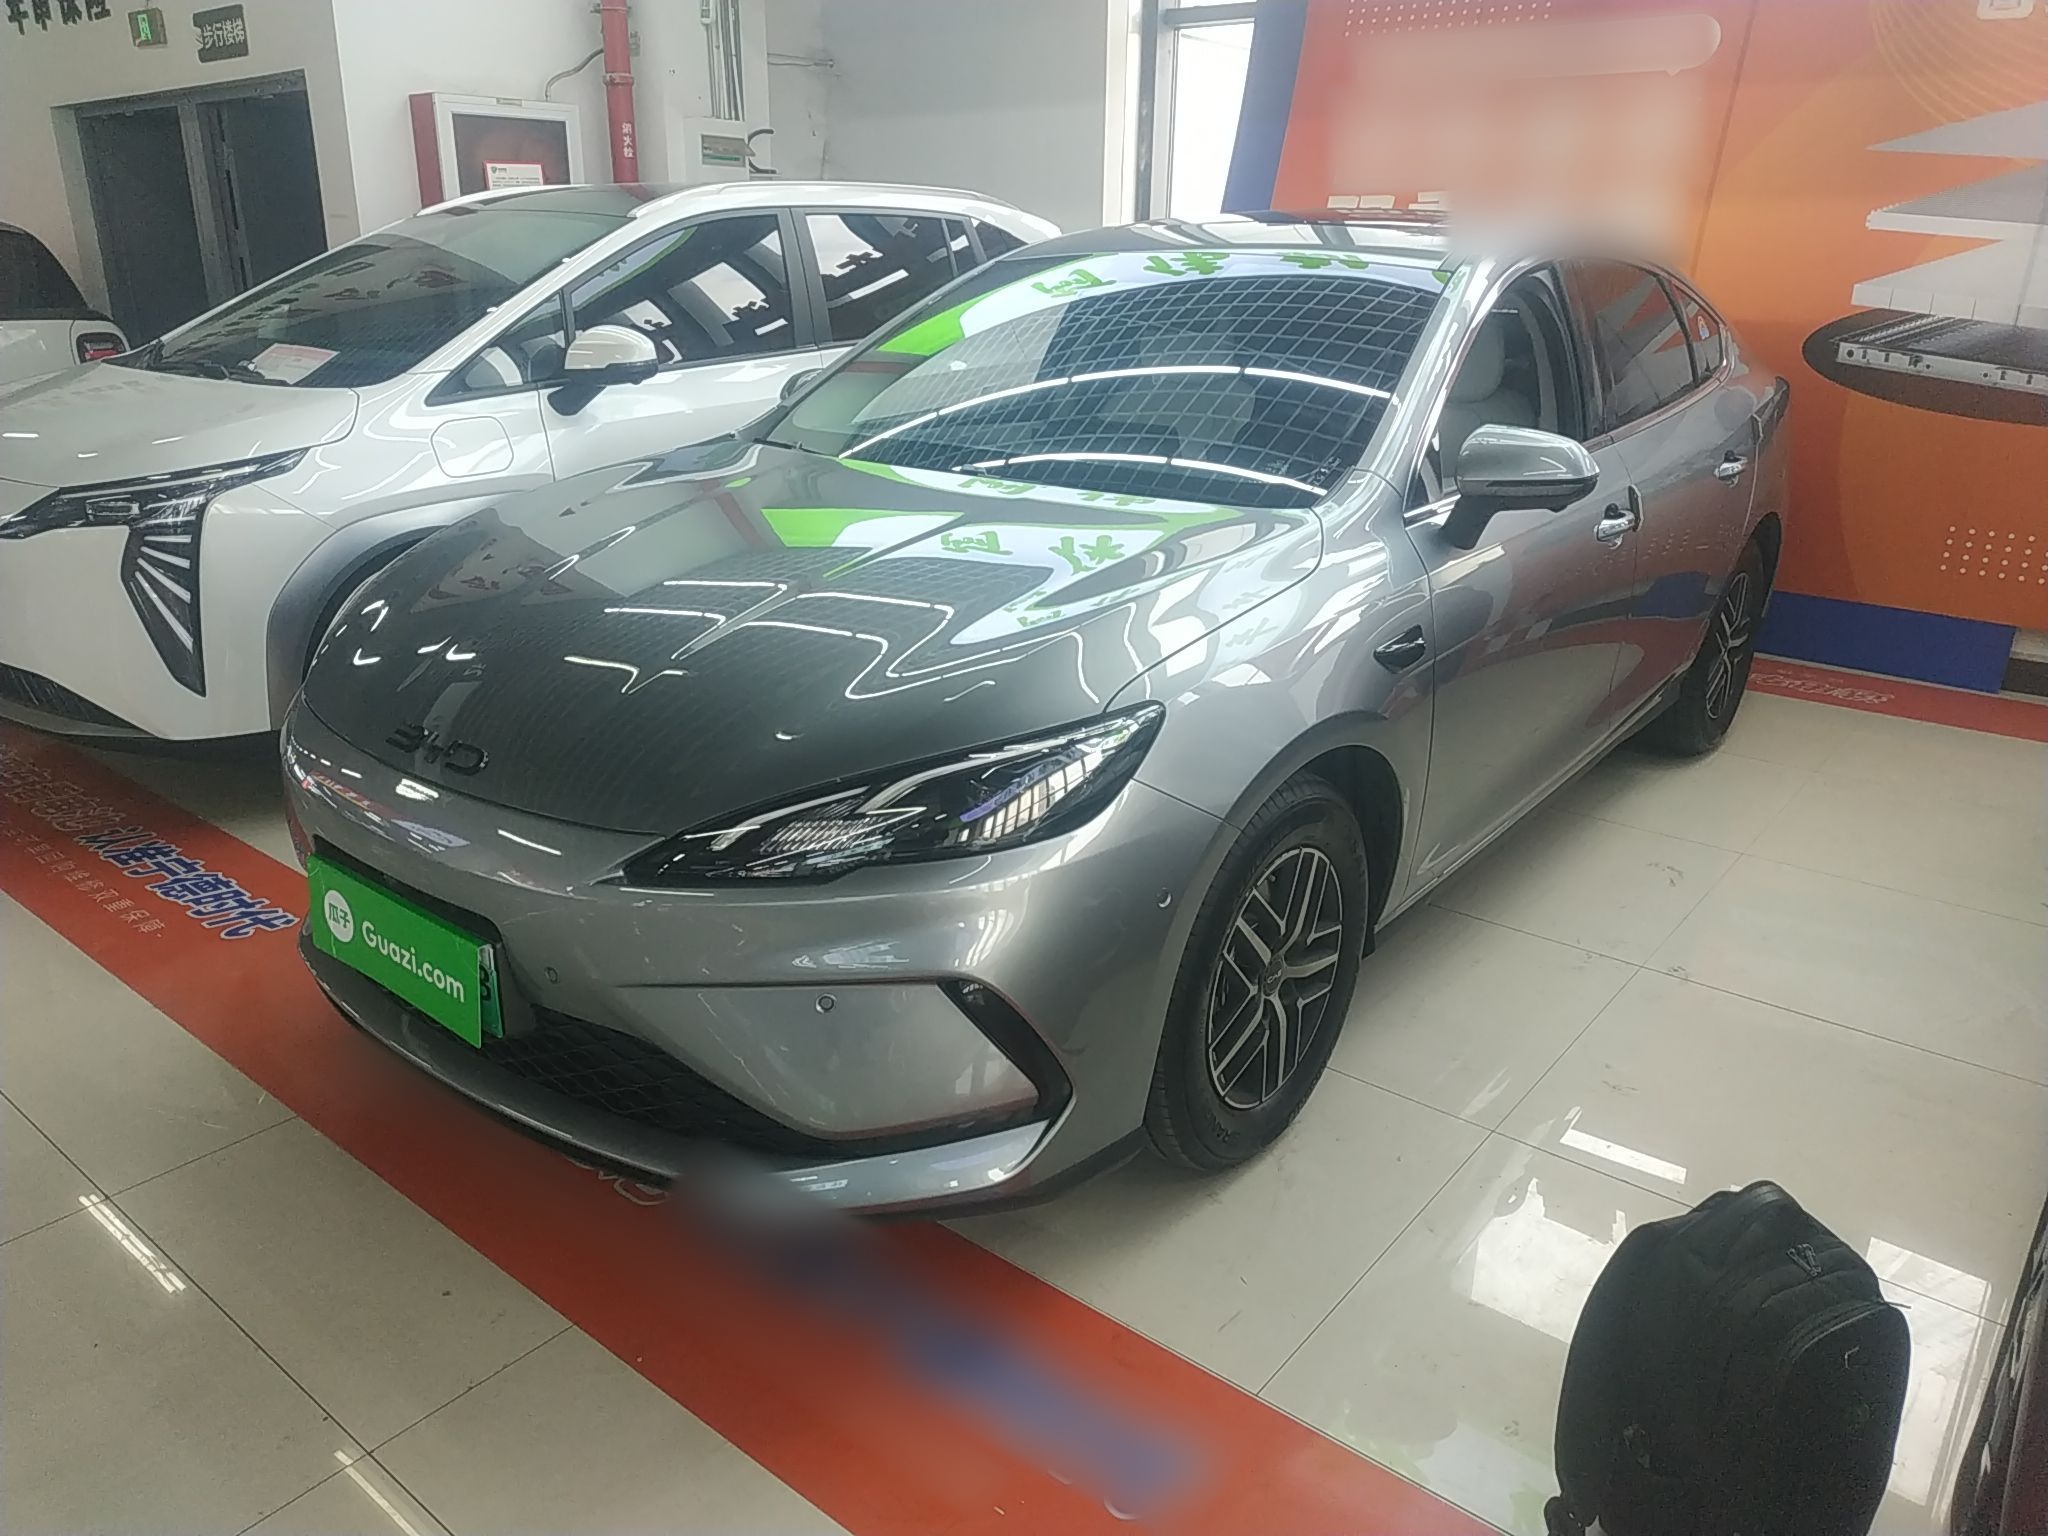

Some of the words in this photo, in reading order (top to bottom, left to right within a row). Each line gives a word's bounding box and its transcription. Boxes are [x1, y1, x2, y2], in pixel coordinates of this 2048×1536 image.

[203, 17, 245, 49] 步行楼梯
[384, 721, 489, 775] BYD
[73, 825, 301, 940] 认准宁德时代
[328, 901, 351, 929] 瓜子
[361, 920, 465, 1003] Guazi.com
